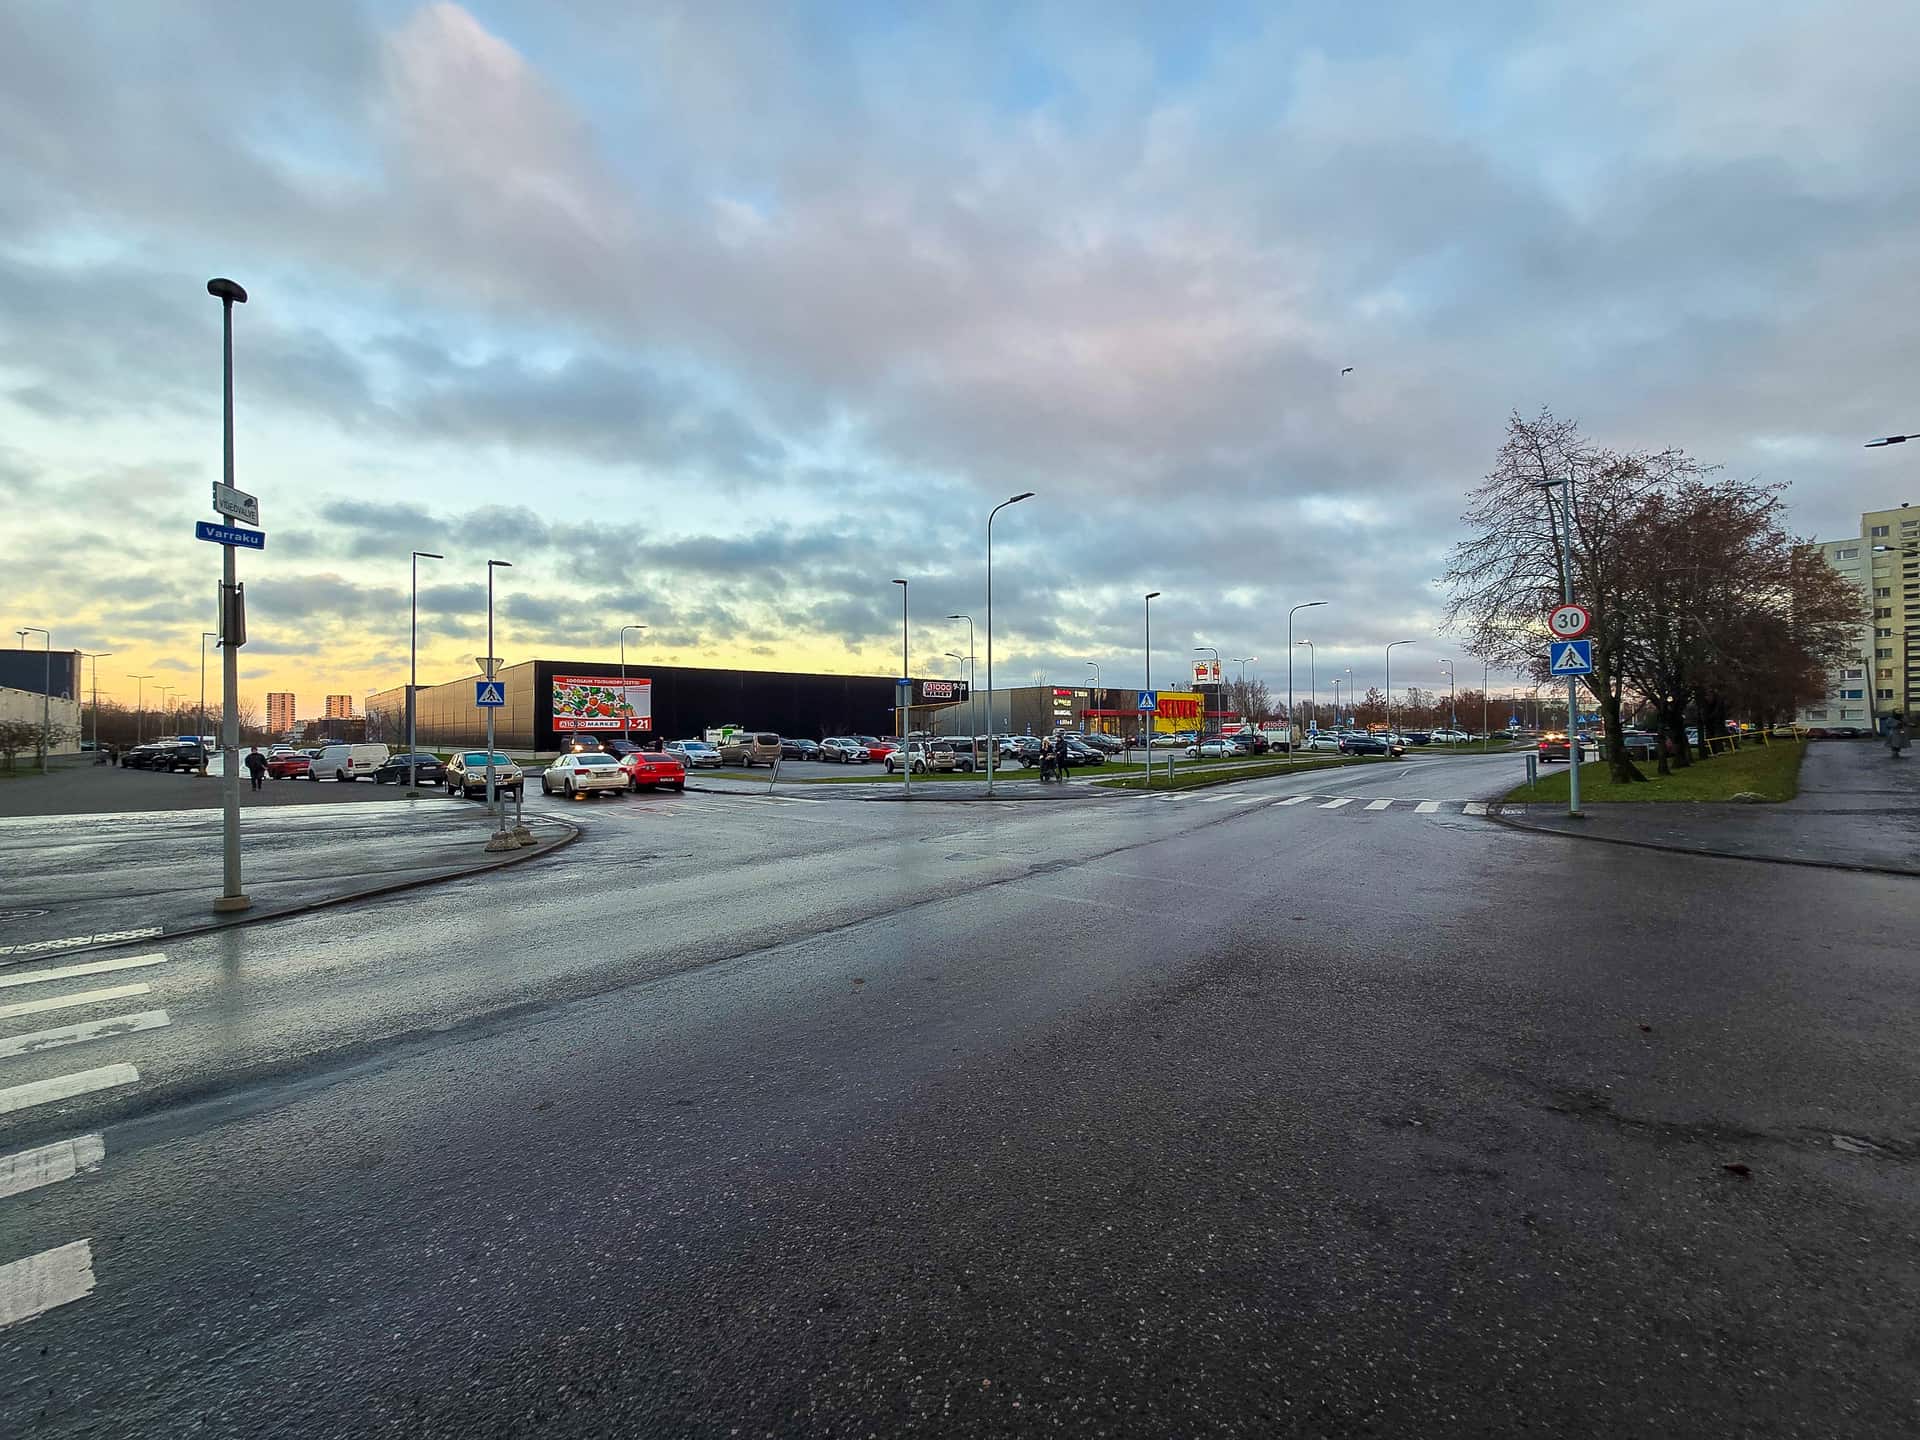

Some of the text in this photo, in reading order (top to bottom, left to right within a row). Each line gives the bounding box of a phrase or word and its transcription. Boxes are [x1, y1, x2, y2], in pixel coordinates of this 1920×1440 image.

[206, 527, 259, 544] Varraku
[1558, 613, 1579, 628] 30
[587, 721, 619, 729] MARKET
